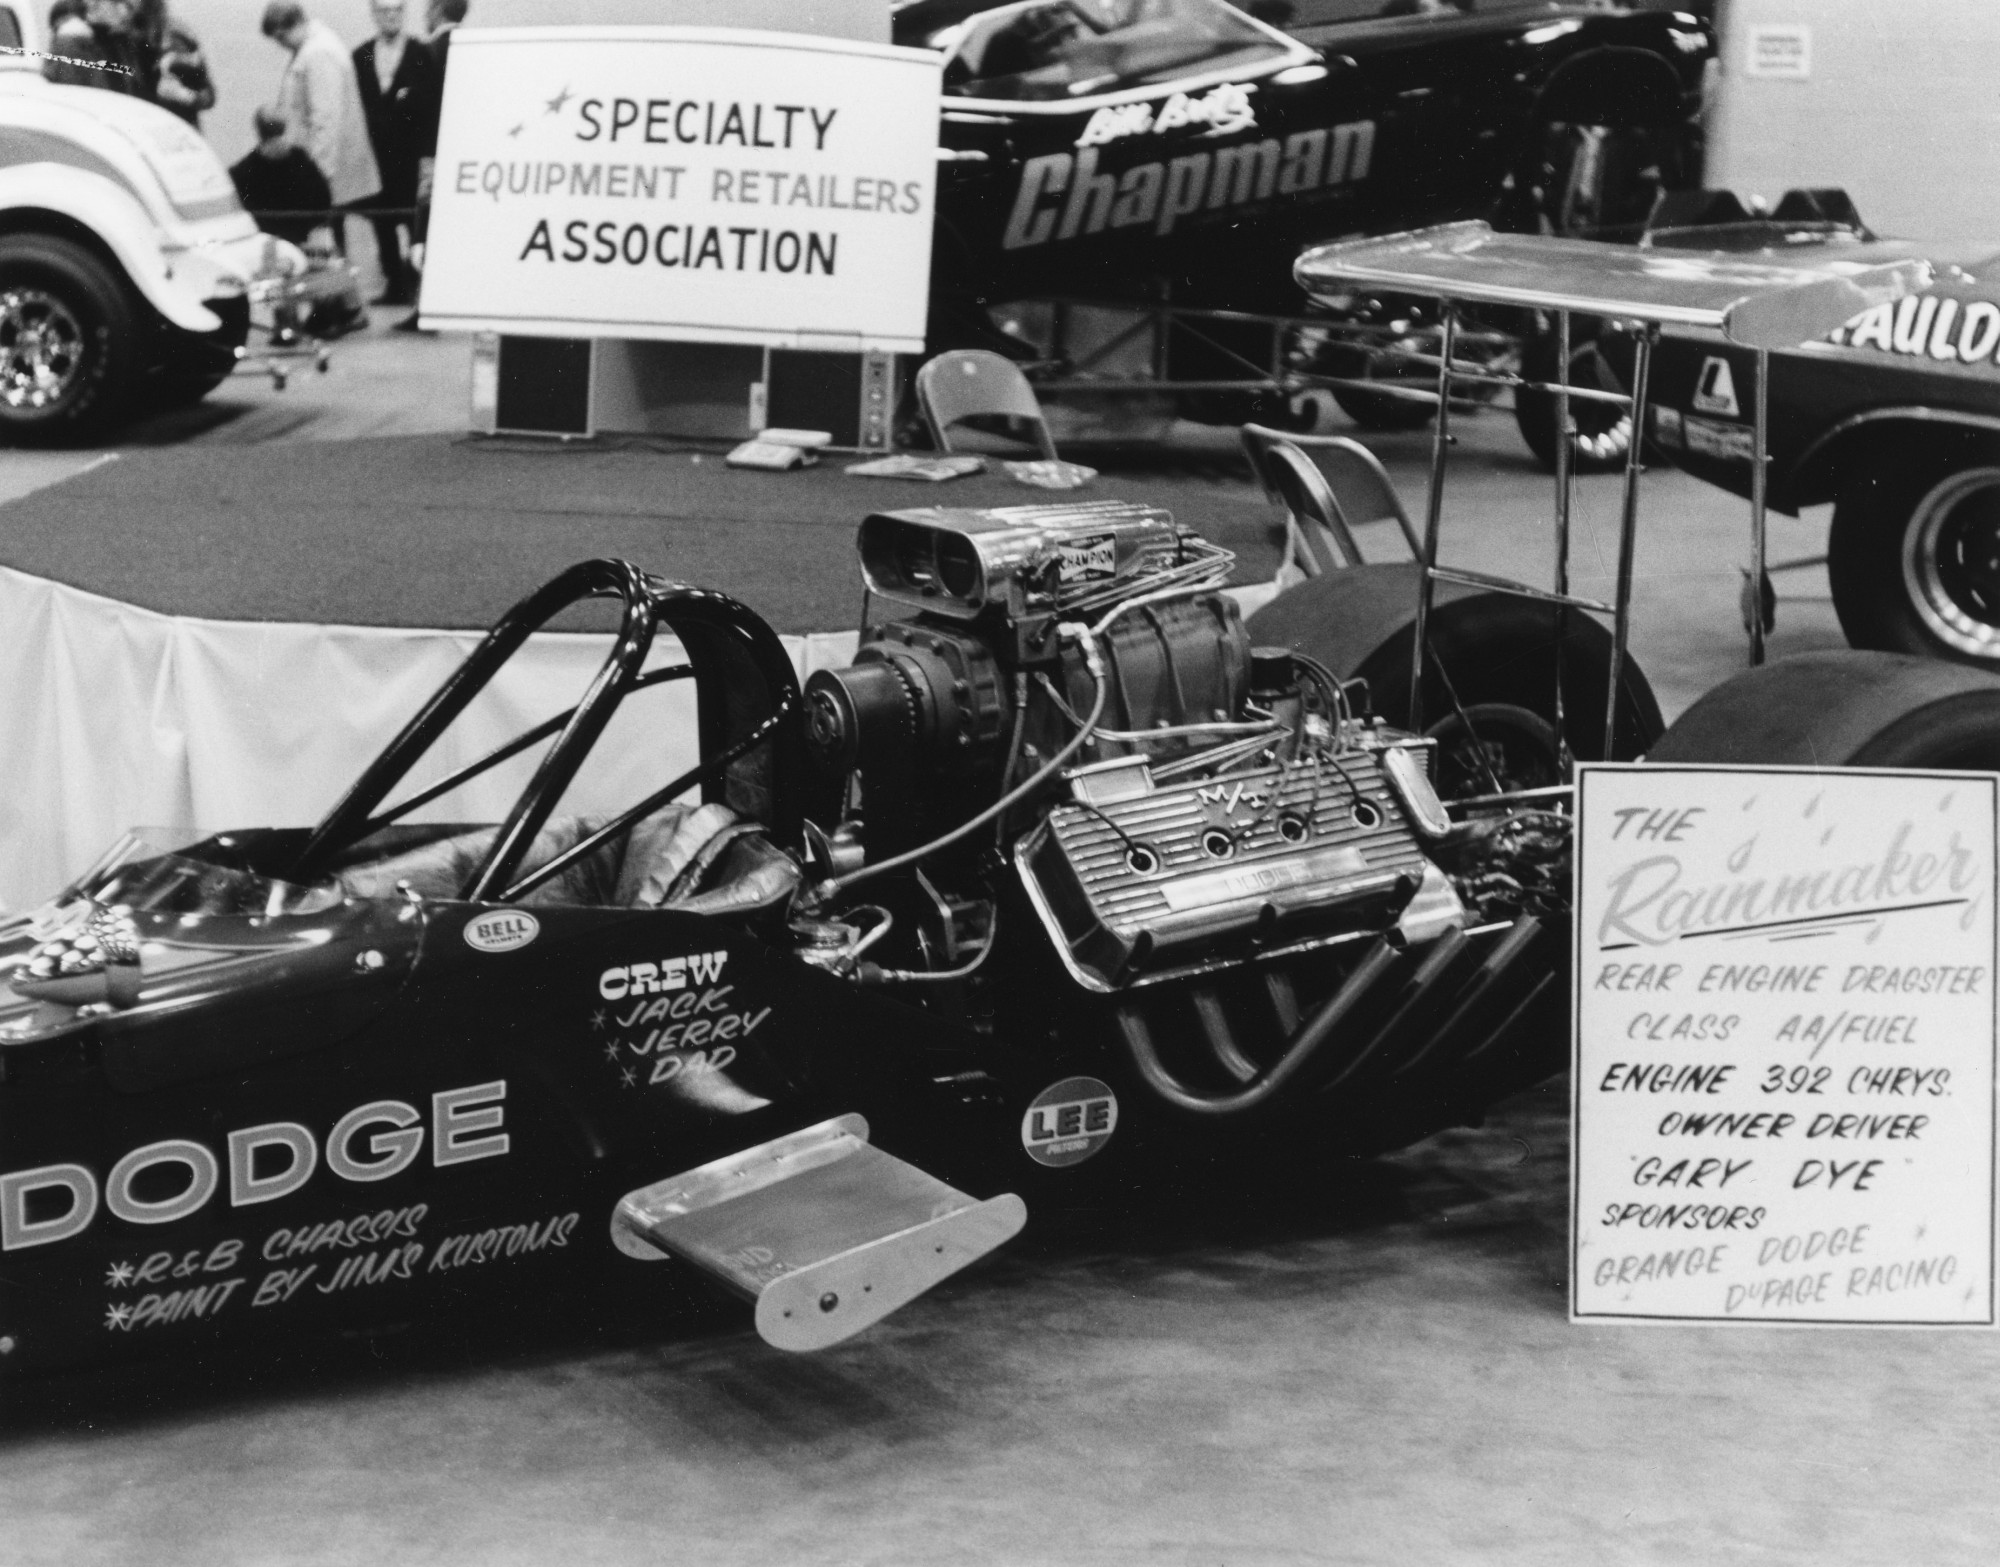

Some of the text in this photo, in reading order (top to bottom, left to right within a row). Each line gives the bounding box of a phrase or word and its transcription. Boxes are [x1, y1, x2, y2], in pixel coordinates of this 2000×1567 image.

[576, 98, 838, 150] SPECIALTY
[455, 161, 922, 215] EQUIPMENT RETAILERS
[1002, 119, 1376, 250] Chapman
[519, 219, 838, 275] ASSOCIATION
[1611, 807, 1706, 842] THE
[1598, 819, 1978, 946] Rainmaker
[477, 919, 528, 938] BELL
[599, 950, 728, 1000] CREW
[1595, 963, 1985, 995] REAR ENGINE DRAGSTER
[616, 985, 735, 1027] JACK
[629, 1006, 772, 1055] JERRY
[1626, 1010, 1918, 1061] CLASS AA/FUEL
[649, 1046, 736, 1084] DAD
[1599, 1062, 1953, 1097] ENGINE 392 CHRYS.
[1031, 1100, 1109, 1141] LEE
[1657, 1111, 1930, 1140] OWNER DRIVER
[0, 1080, 509, 1251] DODGE
[263, 1203, 428, 1261] CHASSIS
[1600, 1202, 1767, 1231] SPONSORS
[122, 1277, 245, 1331] PAINT
[251, 1264, 317, 1307] BY
[427, 1213, 580, 1273] KUSTOMS
[1594, 1223, 1870, 1288] GRANGE DODGE
[1845, 1254, 1957, 1298] RACING
